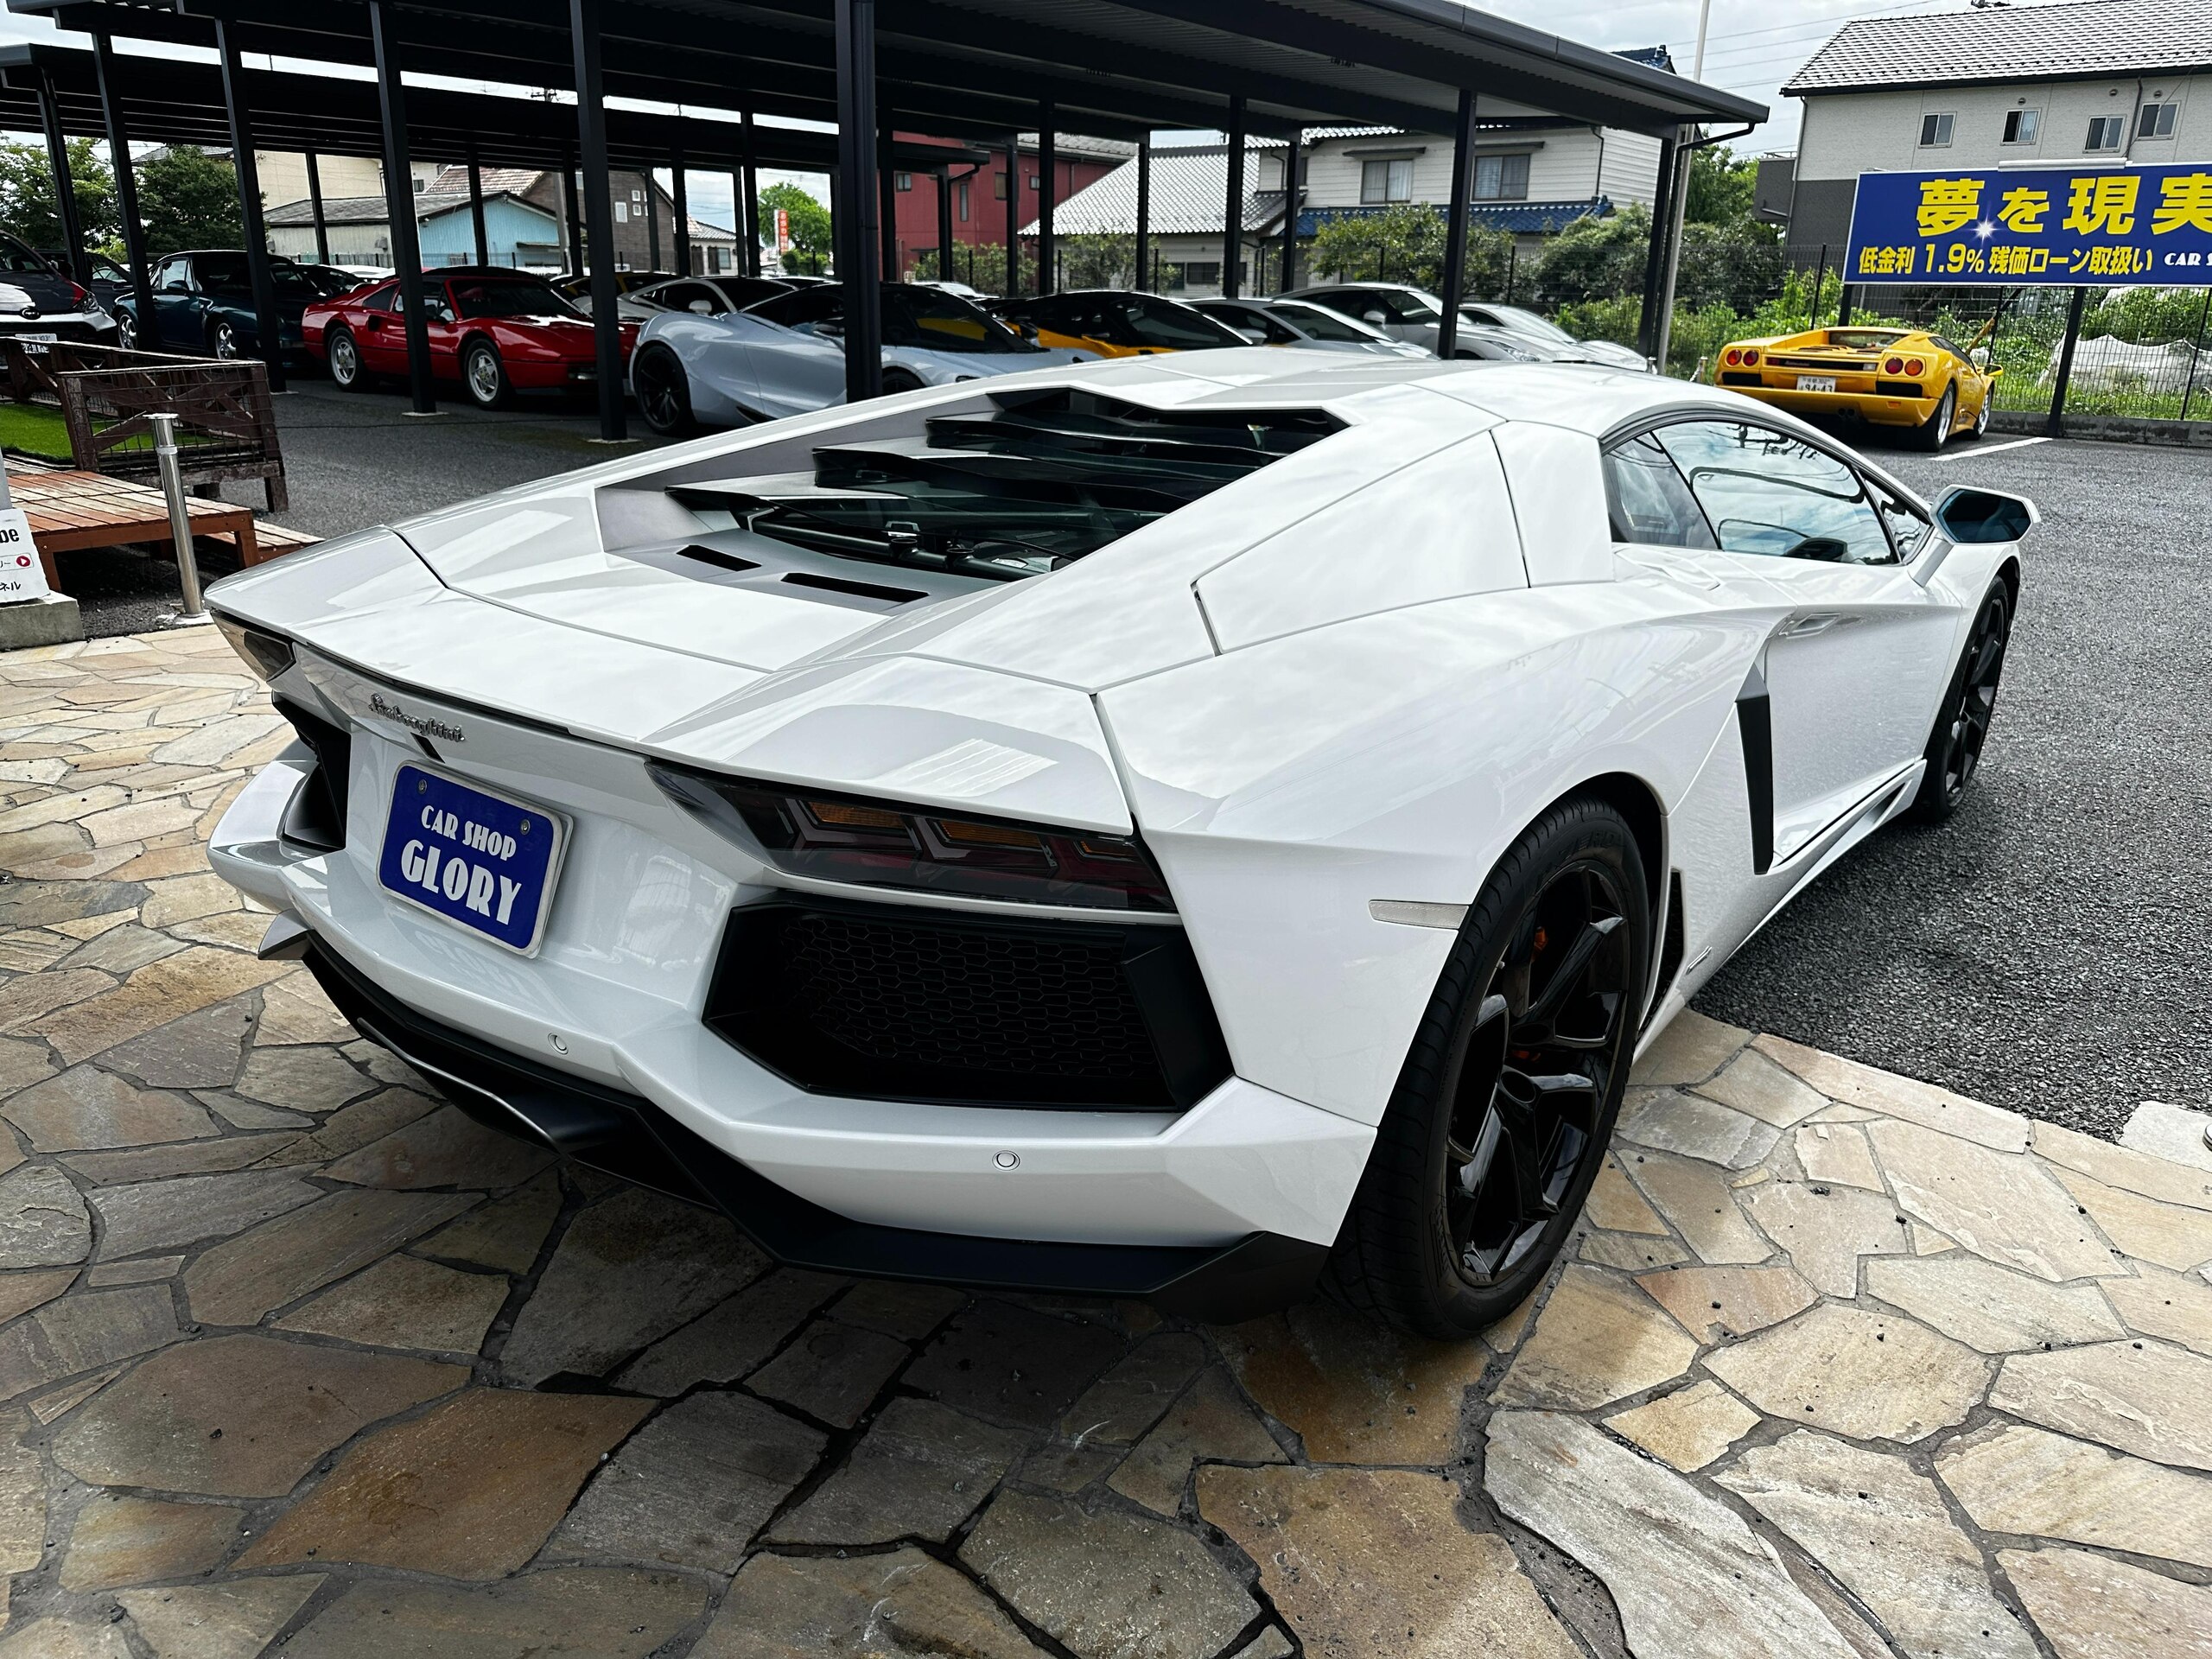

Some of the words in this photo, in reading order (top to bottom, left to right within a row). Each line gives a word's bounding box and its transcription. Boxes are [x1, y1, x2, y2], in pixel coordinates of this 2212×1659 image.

[1859, 245, 1916, 275] 低金利
[1925, 243, 1985, 273] 1.9%
[1987, 245, 2153, 275] 残価ローン取扱い
[2164, 252, 2202, 266] CAR
[421, 804, 459, 841] CAR
[462, 821, 517, 861] SHOP
[401, 839, 522, 925] GLORY
